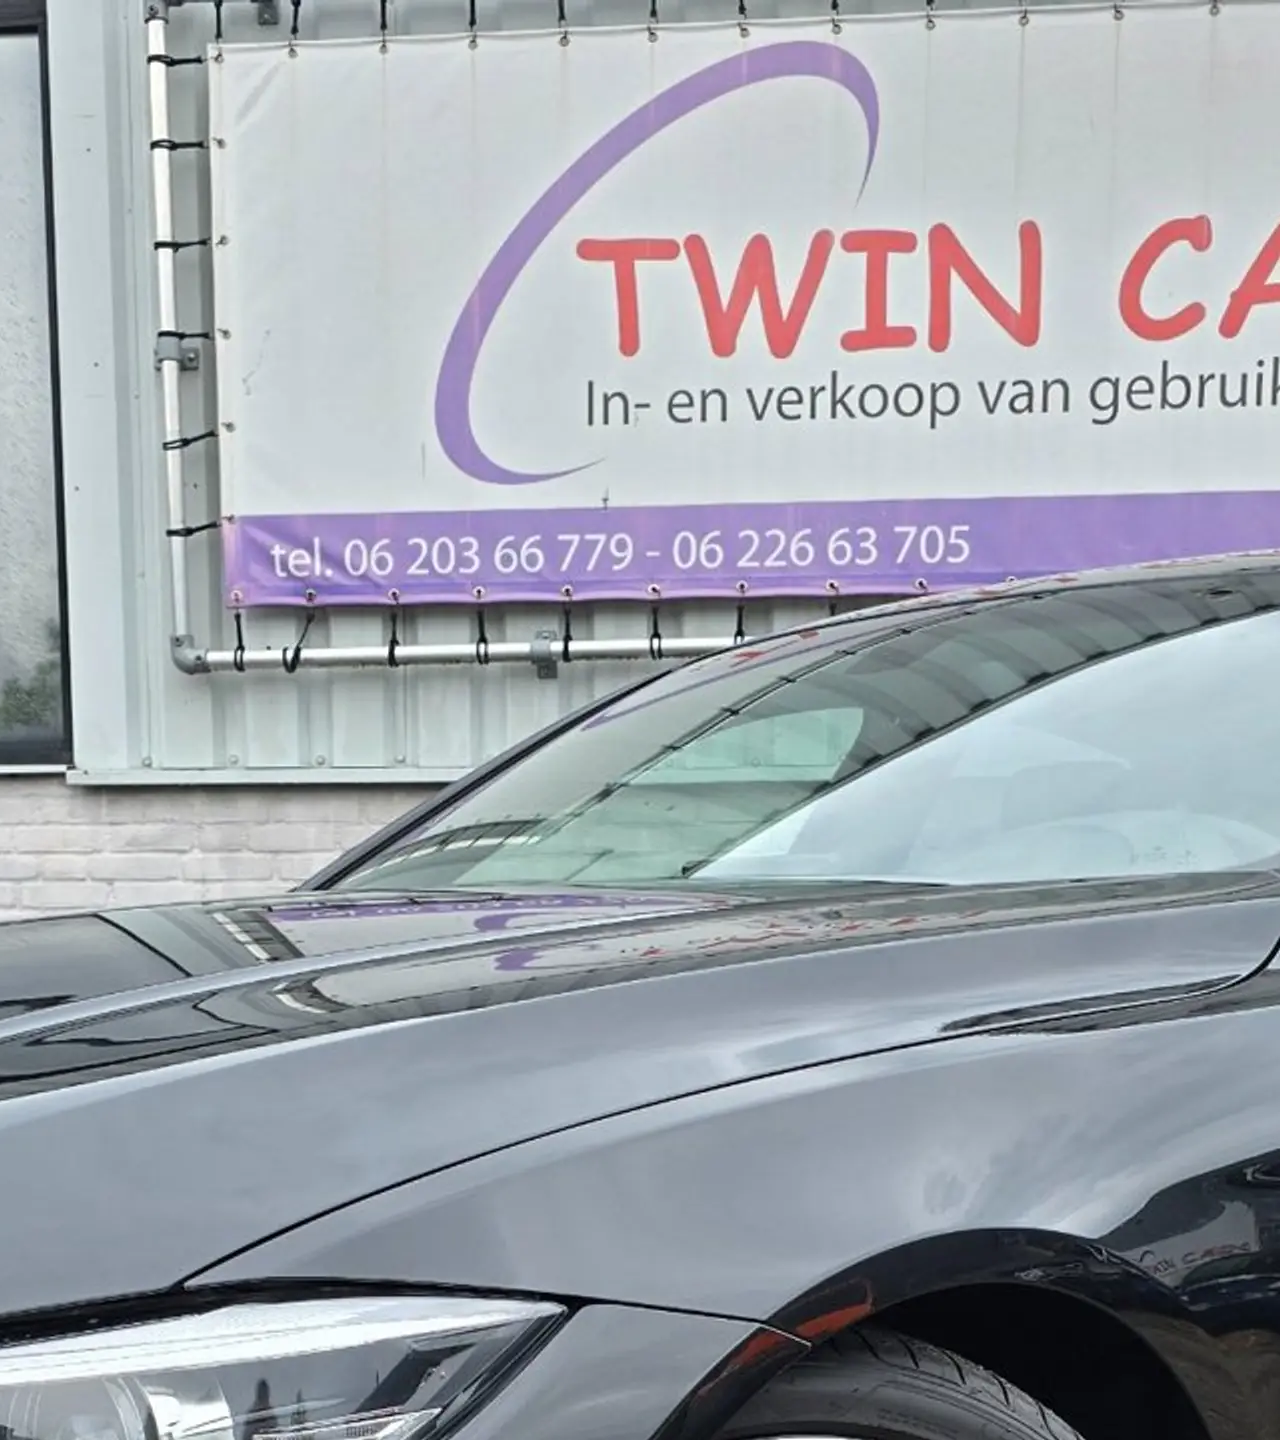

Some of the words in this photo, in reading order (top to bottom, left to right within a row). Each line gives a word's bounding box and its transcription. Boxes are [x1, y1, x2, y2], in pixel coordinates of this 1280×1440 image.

[576, 222, 1042, 359] TWIN
[586, 380, 652, 428] In-
[666, 388, 728, 425] en
[746, 370, 961, 431] verkoop
[977, 378, 1071, 416] van
[270, 536, 334, 578] tel.
[344, 538, 394, 576] 06
[406, 536, 480, 575] 203
[494, 534, 545, 574] 66
[557, 533, 633, 572] 779
[672, 530, 724, 569] 06
[737, 528, 815, 568] 226
[827, 526, 879, 566] 63
[893, 525, 970, 565] 705
